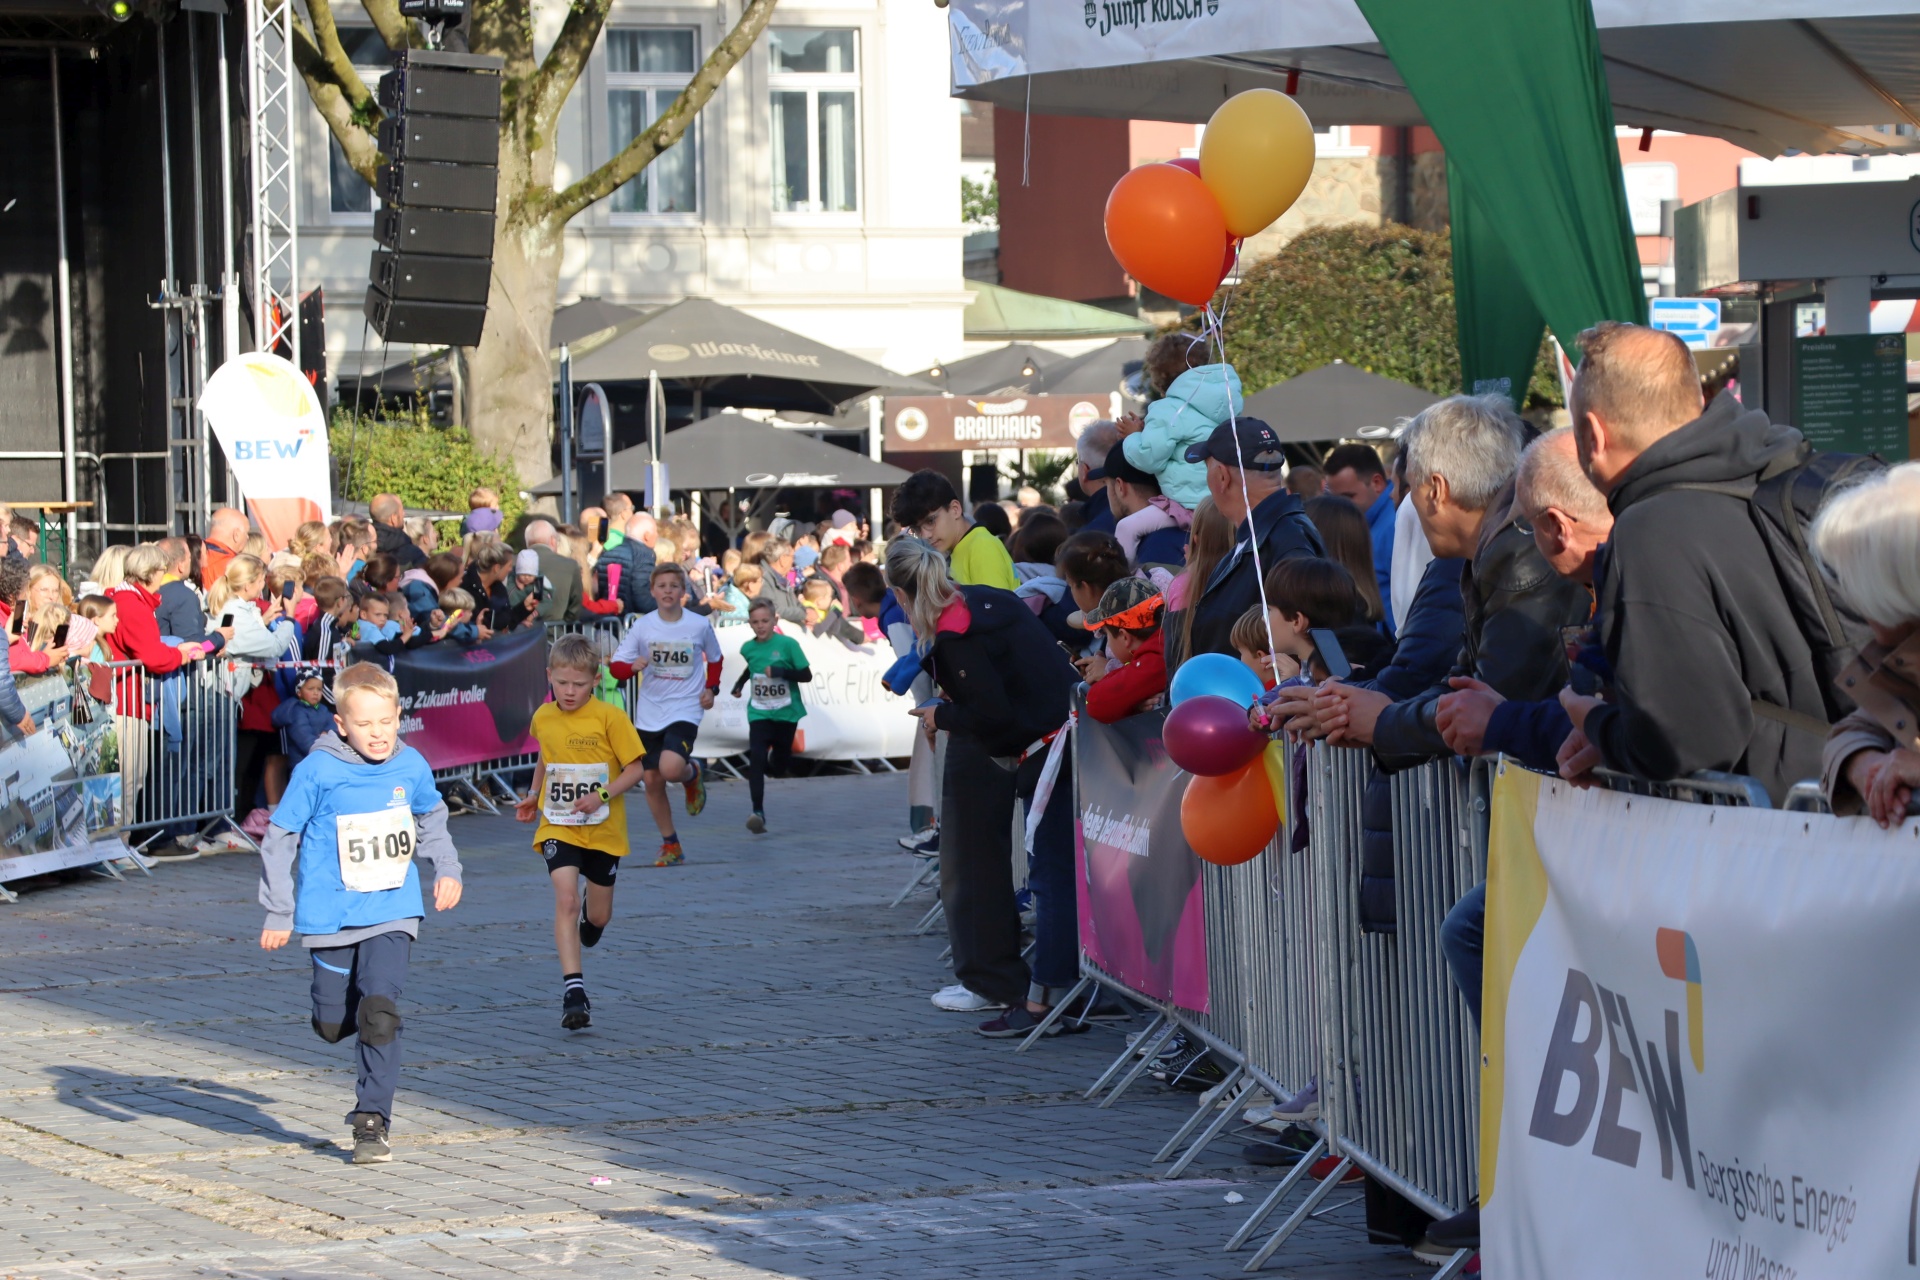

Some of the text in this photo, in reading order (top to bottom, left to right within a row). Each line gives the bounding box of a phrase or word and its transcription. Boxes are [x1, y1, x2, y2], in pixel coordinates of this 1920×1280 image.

[691, 341, 821, 368] Warsteiner
[954, 415, 1042, 441] BRAUHAUS
[235, 438, 303, 460] BEW
[652, 650, 689, 664] 5746
[754, 684, 786, 697] 5266
[845, 660, 880, 704] Für
[414, 687, 459, 709] Zukunft
[460, 684, 487, 704] voller
[348, 830, 411, 863] 5109
[1528, 968, 1695, 1190] BEW
[1698, 1150, 1785, 1223] Bergische
[1791, 1175, 1857, 1253] Energie
[1705, 1235, 1742, 1280] und
